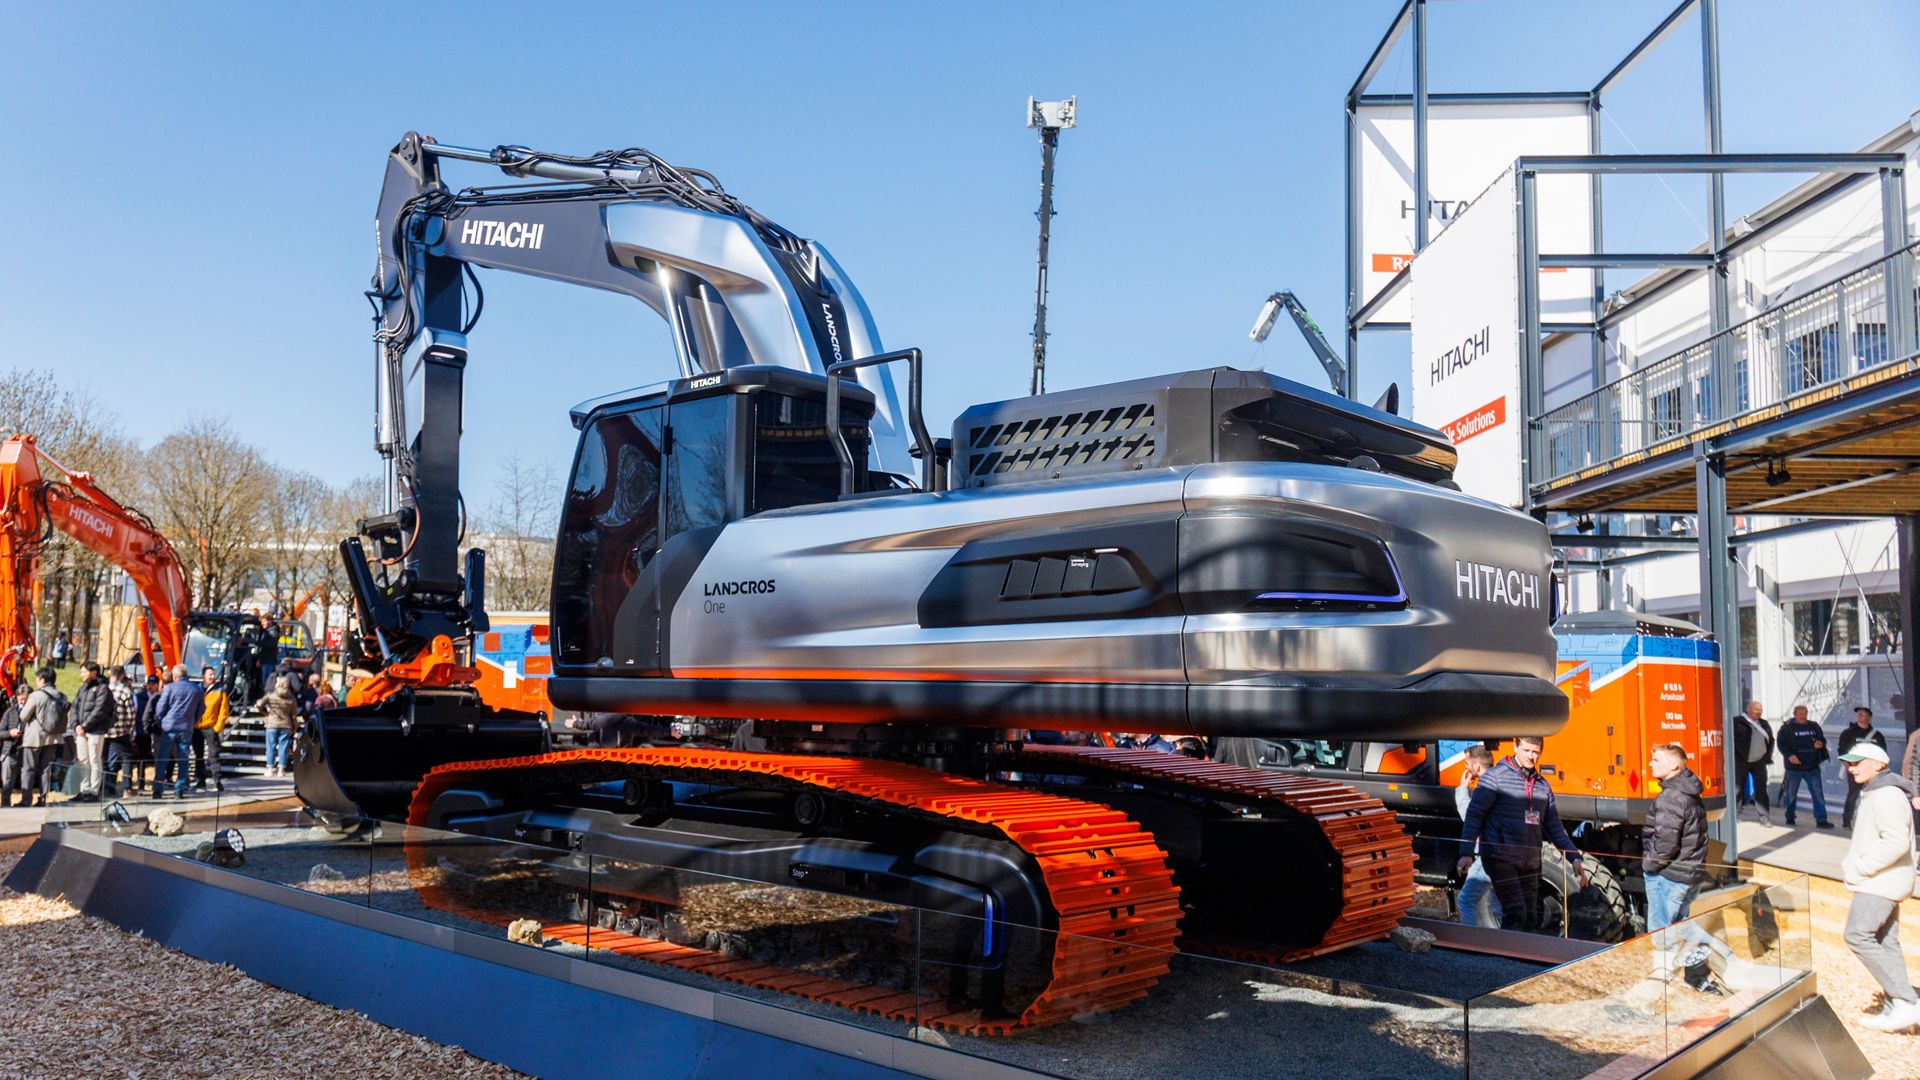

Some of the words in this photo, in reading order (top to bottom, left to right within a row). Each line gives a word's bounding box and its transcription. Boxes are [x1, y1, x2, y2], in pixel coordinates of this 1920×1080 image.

[1401, 200, 1470, 220] HITA
[461, 219, 544, 250] HITACHI
[822, 303, 842, 363] LANDCRO
[1430, 325, 1490, 387] HITACHI
[690, 375, 721, 389] HITACHI
[1456, 409, 1496, 440] Solutions
[69, 504, 114, 538] HITACHI
[704, 579, 776, 596] LANDCROS
[1455, 559, 1540, 609] HITACHI
[704, 600, 726, 614] One
